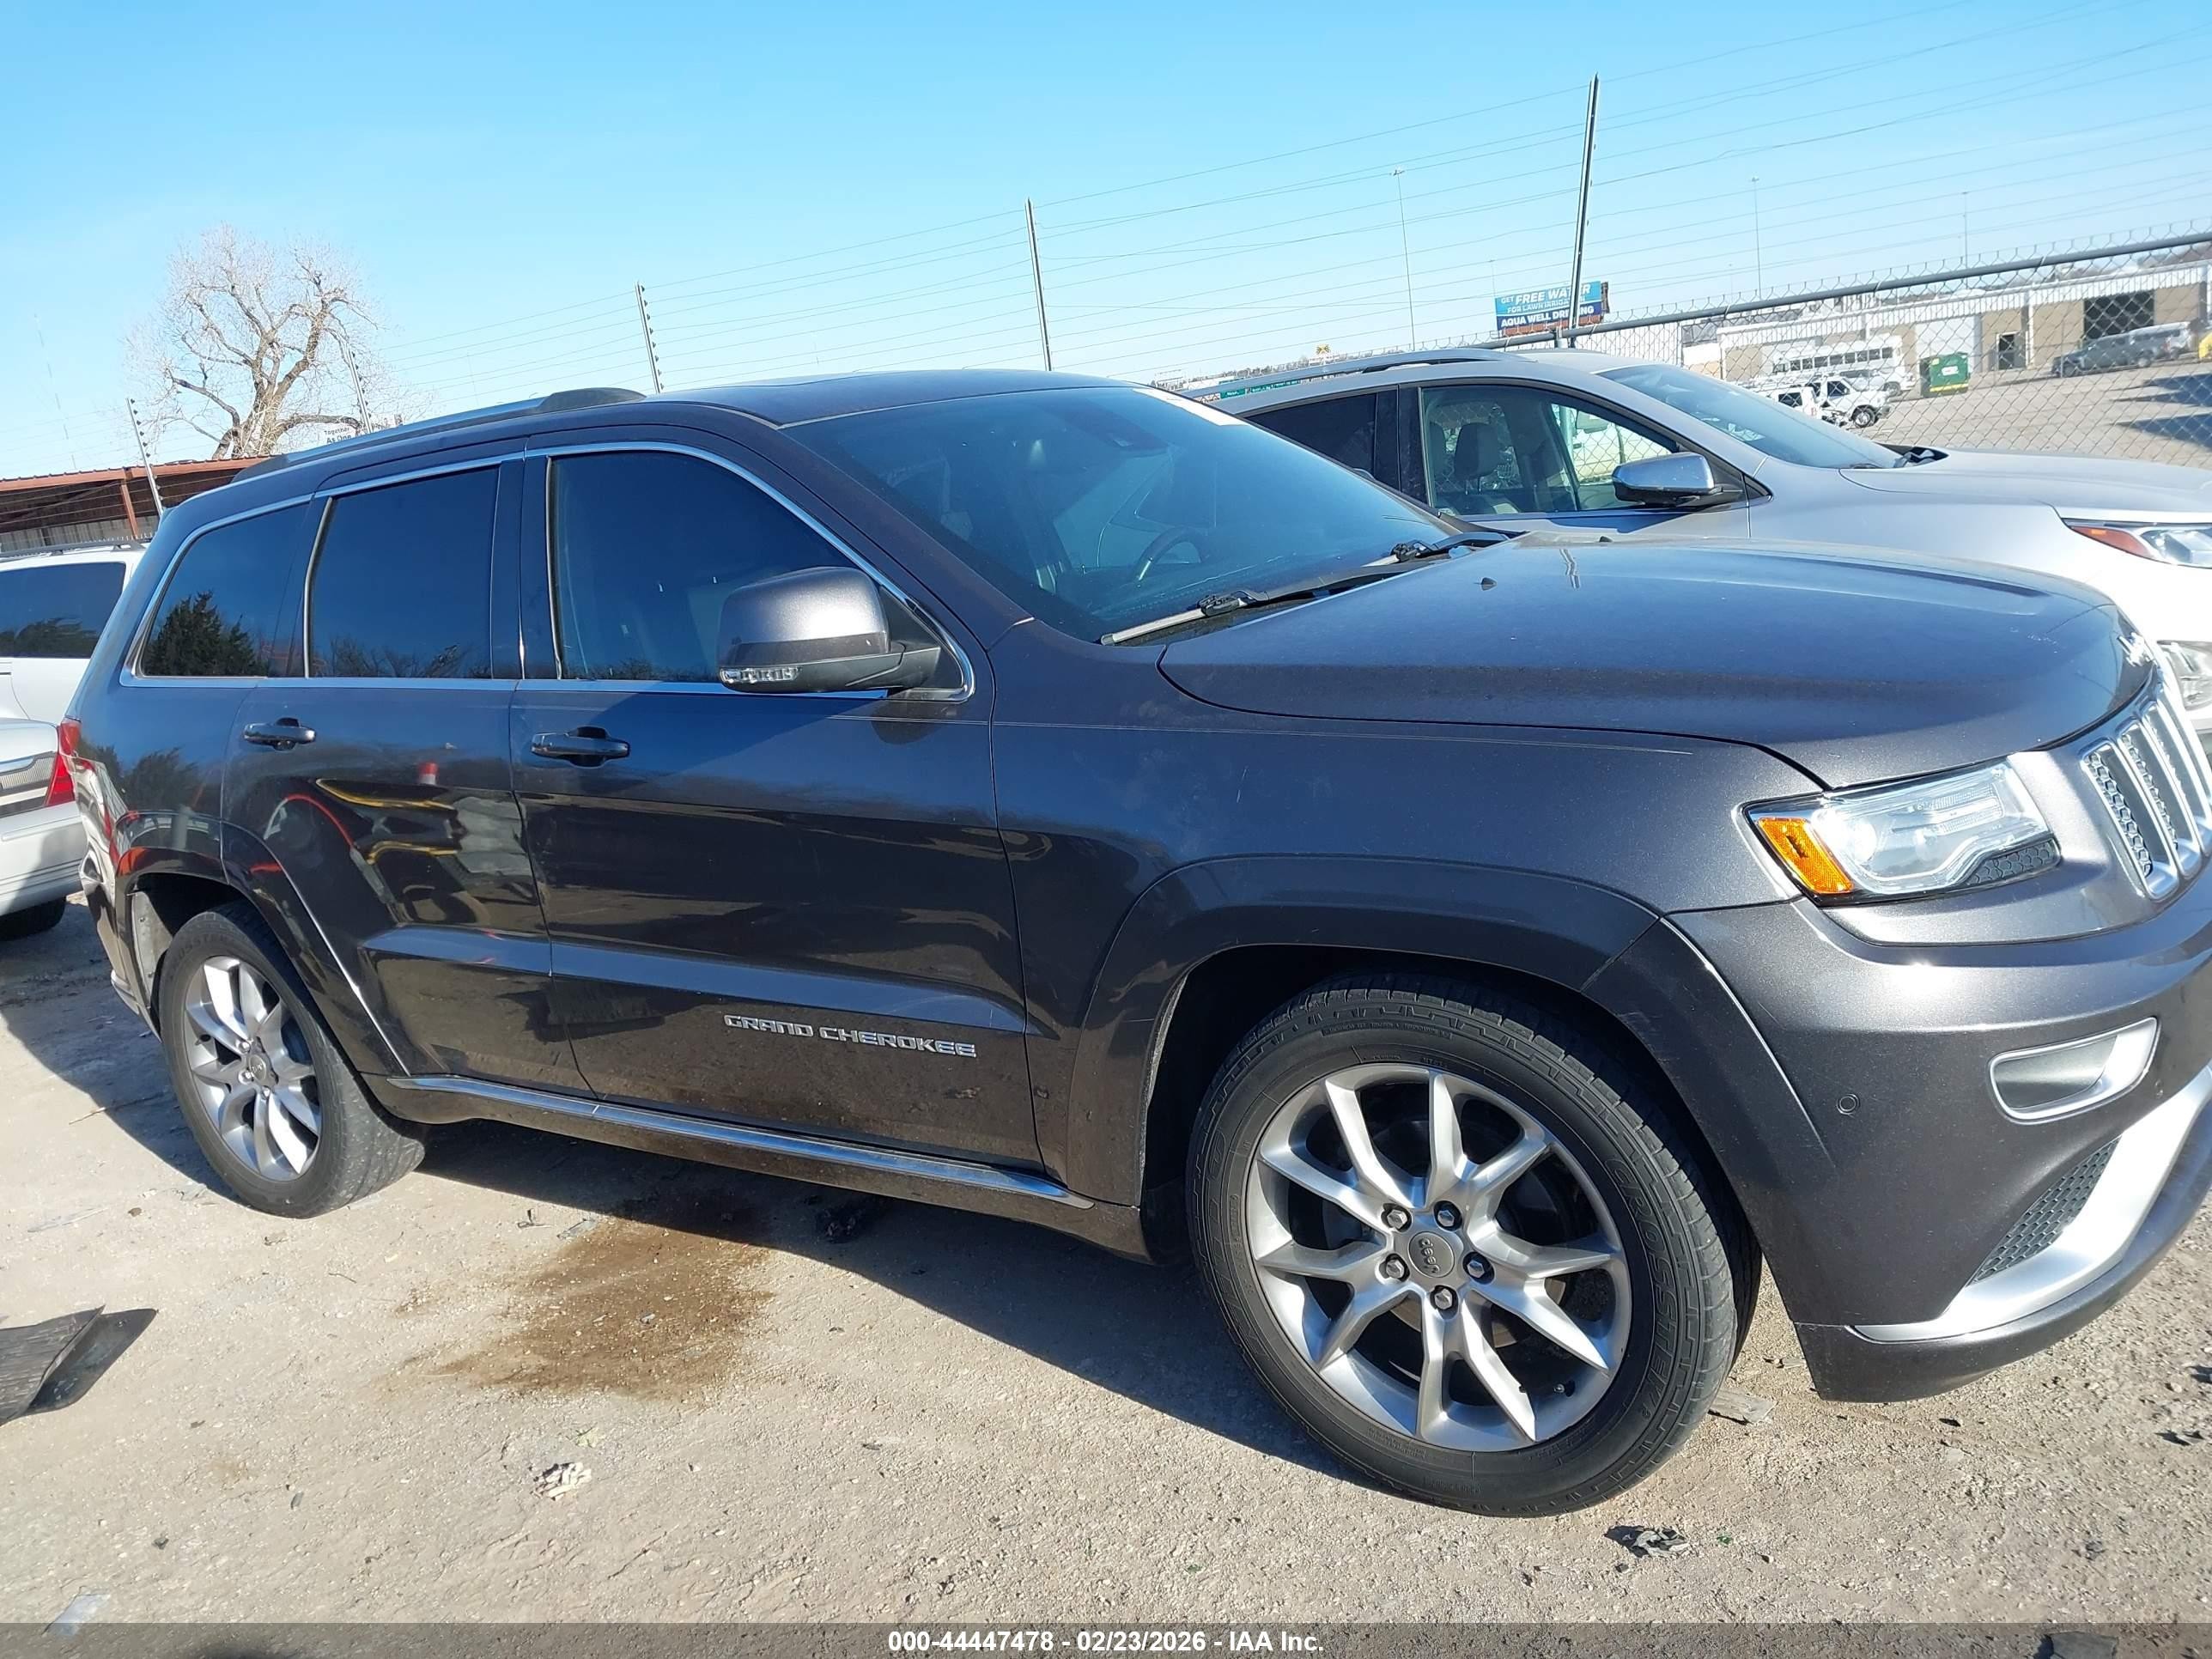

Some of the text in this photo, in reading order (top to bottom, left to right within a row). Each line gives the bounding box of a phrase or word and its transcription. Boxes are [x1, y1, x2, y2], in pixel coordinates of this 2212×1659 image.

[1515, 291, 1545, 305] FREE
[1547, 283, 1591, 300] WATR
[1507, 305, 1522, 313] FOR
[1522, 301, 1543, 311] LAWN
[1501, 315, 1527, 327] AQUA
[1527, 311, 1552, 323] WELL
[723, 1013, 977, 1058] GRAND CHEROKEE
